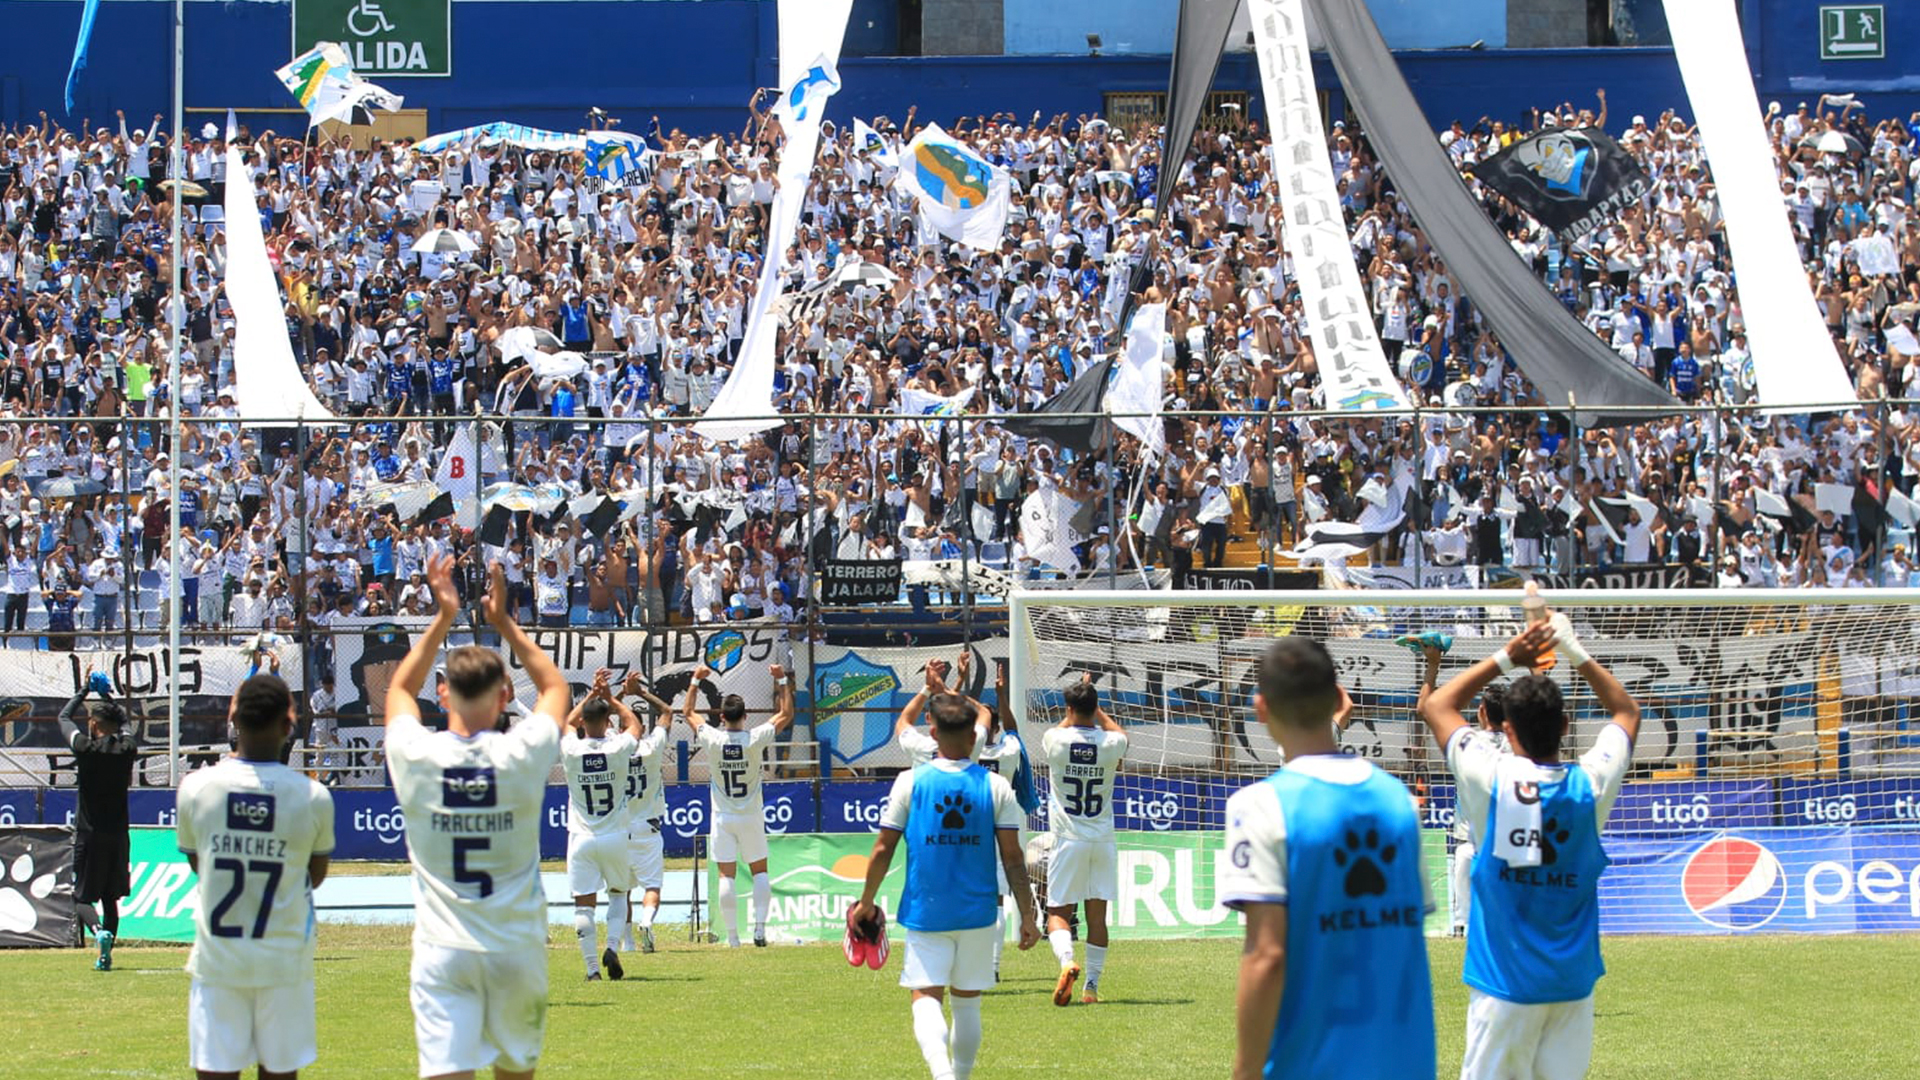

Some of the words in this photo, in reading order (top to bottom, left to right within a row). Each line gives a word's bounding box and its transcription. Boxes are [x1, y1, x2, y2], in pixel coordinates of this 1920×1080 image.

[340, 41, 428, 69] ALIDA
[450, 456, 465, 479] B
[826, 564, 899, 579] TERRERO
[828, 581, 896, 598] JALAPA
[509, 628, 773, 681] HIFLADS
[721, 770, 748, 798] 15
[1065, 765, 1104, 777] BARRETO
[581, 783, 614, 816] 13
[1062, 776, 1104, 818] 36
[431, 811, 514, 832] FRACCHIA
[664, 800, 704, 838] igo
[925, 835, 981, 846] KELME
[453, 837, 493, 898] 5
[211, 858, 284, 939] 27
[1319, 907, 1419, 932] KELME
